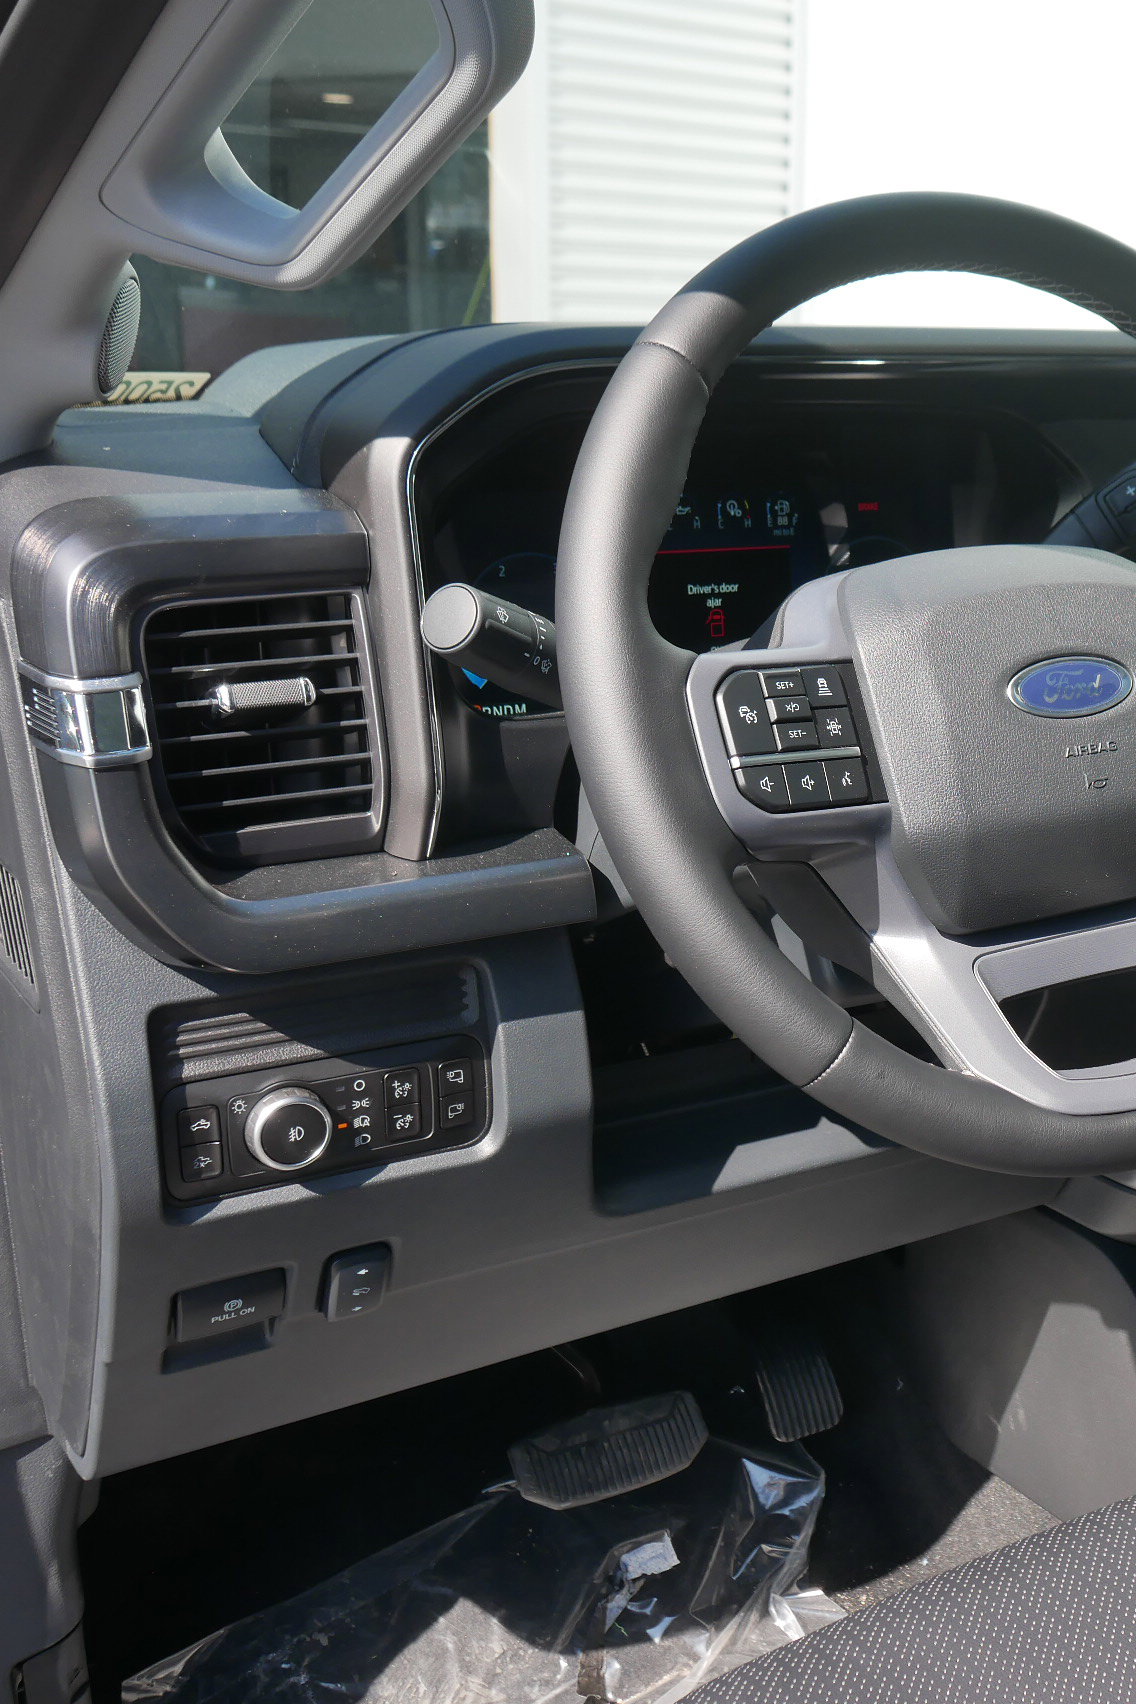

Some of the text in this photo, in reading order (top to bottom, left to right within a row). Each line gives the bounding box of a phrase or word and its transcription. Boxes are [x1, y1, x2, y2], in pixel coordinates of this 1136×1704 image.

[499, 565, 505, 577] 2
[687, 582, 739, 595] Driver's door
[706, 597, 722, 608] ajar
[775, 682, 795, 690] SET+
[1044, 668, 1103, 704] Ford
[473, 703, 527, 716] NDM
[1065, 741, 1118, 759] AIRBAG
[211, 1306, 255, 1323] PULL ON
